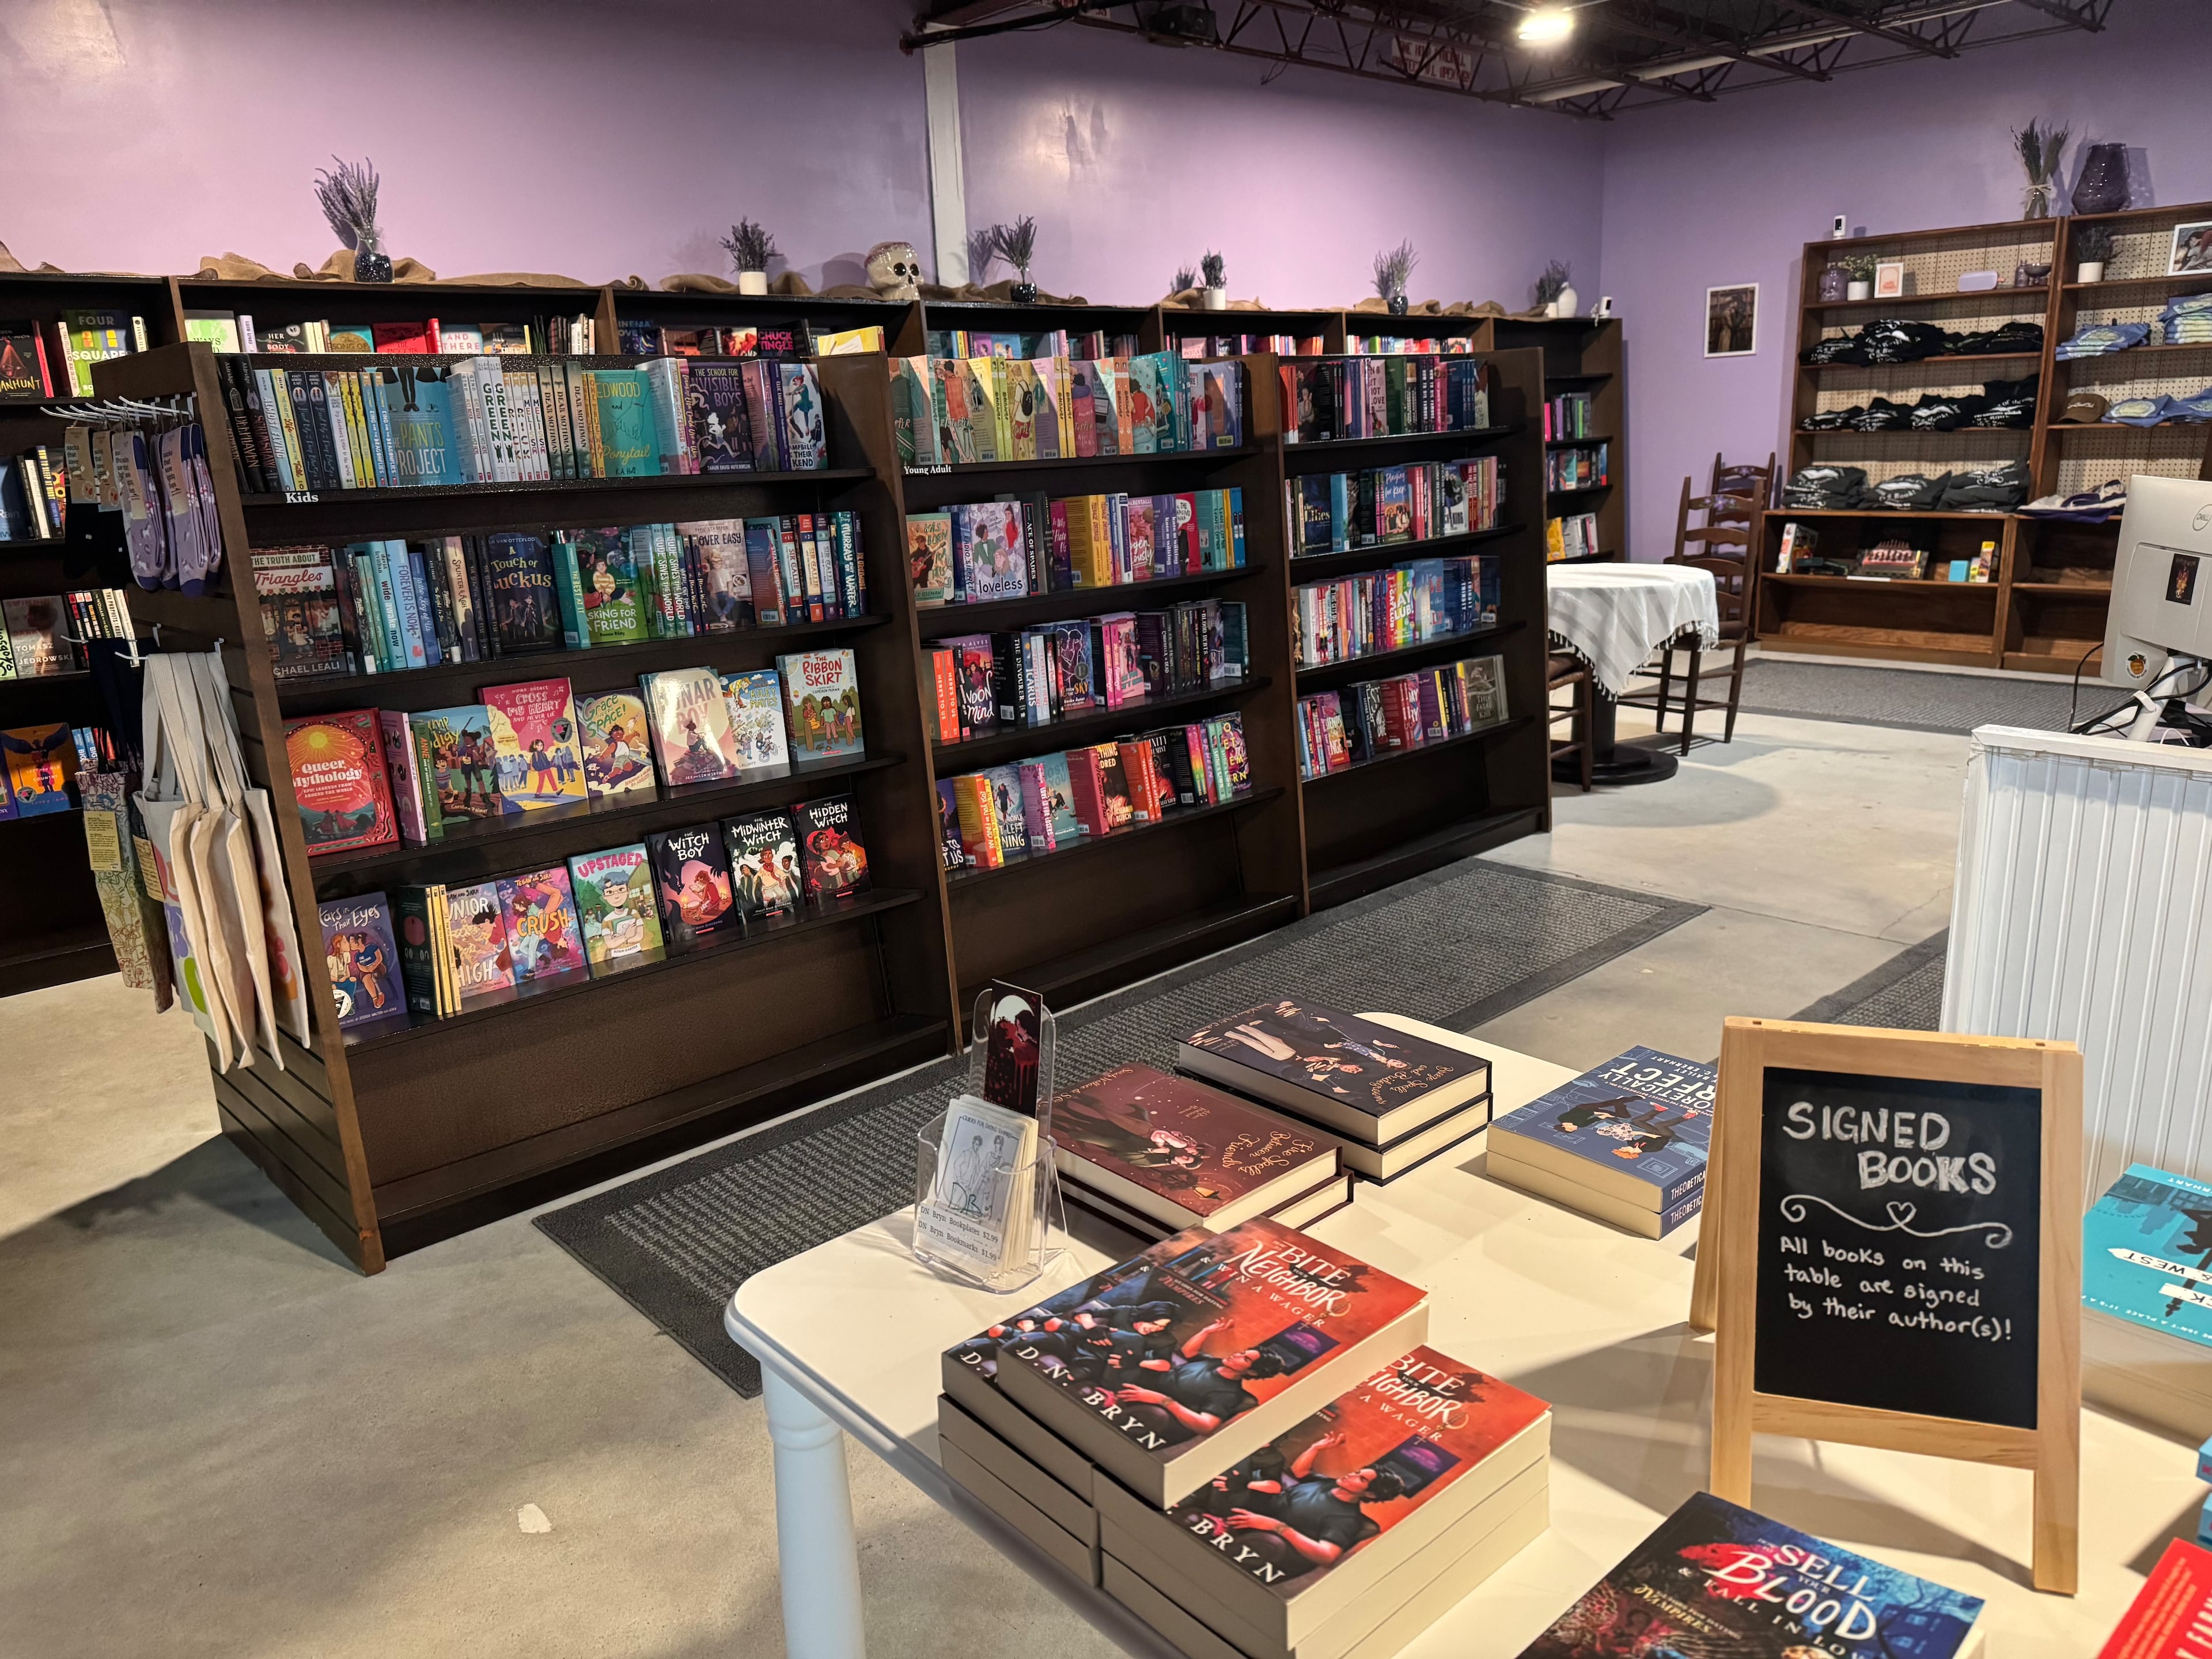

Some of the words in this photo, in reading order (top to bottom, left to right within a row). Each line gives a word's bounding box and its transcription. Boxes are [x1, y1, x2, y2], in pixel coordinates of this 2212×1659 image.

[79, 316, 114, 325] FOUR
[758, 331, 793, 340] CHUCK
[759, 341, 793, 350] TINGLE
[574, 386, 582, 408] DEAR
[612, 401, 623, 410] and
[714, 392, 742, 407] BOYS
[495, 383, 512, 441] GREEN
[263, 397, 276, 428] ALMOST
[272, 431, 285, 459] FLYING
[401, 422, 444, 448] PANTS
[559, 415, 570, 453] MOTHMAN
[577, 410, 586, 448] MOTHMAN
[904, 465, 928, 475] Young
[930, 464, 952, 474] Adult
[286, 492, 319, 503] Kids
[656, 538, 665, 556] JUDE
[699, 533, 720, 546] OVER
[723, 532, 741, 544] EASY
[842, 523, 852, 562] MURRAY
[962, 535, 972, 559] RADIO
[1028, 538, 1035, 548] OF
[266, 556, 290, 564] TRUTH
[293, 554, 316, 563] ABOUT
[509, 546, 516, 555] A
[491, 558, 527, 572] Touch
[529, 560, 537, 568] of
[658, 559, 669, 580] SAVES
[255, 570, 323, 586] Triangles
[662, 581, 671, 593] THE
[979, 578, 1023, 593] loveless
[381, 581, 391, 600] wide
[398, 565, 414, 605] FOREVER
[407, 613, 418, 632] NOW
[573, 581, 581, 597] BEST
[844, 575, 857, 608] WATER
[385, 603, 396, 628] awake
[663, 593, 674, 621] WORLD
[16, 643, 54, 652] TOMASZ
[390, 631, 399, 646] now
[19, 654, 73, 665] JEDROWSKI
[312, 662, 340, 672] LEALI
[802, 657, 843, 675] RIBBON
[805, 672, 843, 687] SKIRT
[1025, 668, 1036, 707] ICARUS
[1074, 682, 1089, 695] SKY
[516, 692, 548, 705] CROSS
[749, 688, 776, 698] RILEY
[749, 697, 778, 709] MAYES
[950, 698, 955, 707] TO
[507, 706, 525, 717] MY
[528, 699, 561, 716] HEART
[527, 713, 544, 721] NEVER
[582, 694, 618, 722] Grace
[951, 709, 956, 718] US
[586, 704, 627, 738] SPACE!
[420, 737, 430, 758] ANNE
[301, 760, 345, 774] Queer
[293, 768, 363, 788] Mythology
[1116, 813, 1131, 823] BURCH
[985, 823, 993, 838] FIND
[989, 839, 995, 849] ME
[1007, 823, 1024, 834] LEFT
[677, 846, 705, 861] BOY
[577, 853, 643, 878] UPSTAGED
[514, 875, 532, 886] TEGAN
[353, 904, 380, 927] Eyes
[516, 908, 569, 937] CRUSH
[455, 960, 497, 988] HIGH
[1651, 1056, 1700, 1074] EBERHART
[1673, 1068, 1710, 1080] BAILEY
[1783, 1101, 1950, 1150] SIGNED
[1222, 1134, 1260, 1168] Friends
[1249, 1131, 1291, 1157] Between
[1282, 1139, 1314, 1156] Fire
[1238, 1155, 1289, 1176] Spells
[1858, 1150, 1996, 1195] BOOKS
[921, 1206, 929, 1215] DN
[933, 1211, 946, 1222] Bryn
[949, 1217, 980, 1236] Bookplates
[983, 1232, 998, 1244] $2.99
[918, 1221, 927, 1230] DN
[930, 1225, 944, 1237] Bryn
[946, 1233, 979, 1253] Bookmarks
[981, 1249, 997, 1262] $1.99
[1276, 1241, 1352, 1287] BITE
[1780, 1236, 1808, 1255] All
[1822, 1240, 1885, 1266] books
[1902, 1258, 1926, 1270] on
[1940, 1257, 1985, 1280] this
[2123, 1252, 2186, 1275] WEST
[1224, 1240, 1351, 1317] NEIGHBOR
[1784, 1263, 1843, 1288] table
[1859, 1280, 1893, 1294] are
[1904, 1283, 1979, 1309] signed
[1218, 1263, 1250, 1284] WIN
[1251, 1285, 1262, 1293] A
[1270, 1292, 1325, 1328] WAGER
[1789, 1293, 1813, 1319] by
[1823, 1297, 1876, 1320] their
[1888, 1311, 2012, 1342] author(s)!
[1082, 1392, 1168, 1452] BRYN
[1380, 1403, 1442, 1442] WAGER
[1189, 1518, 1287, 1585] BRYN
[1772, 1544, 1876, 1602] SELL
[1797, 1575, 1831, 1595] YOUR
[1699, 1551, 1877, 1641] BLOOD
[1703, 1578, 1760, 1614] FALL
[1772, 1615, 1802, 1635] IN
